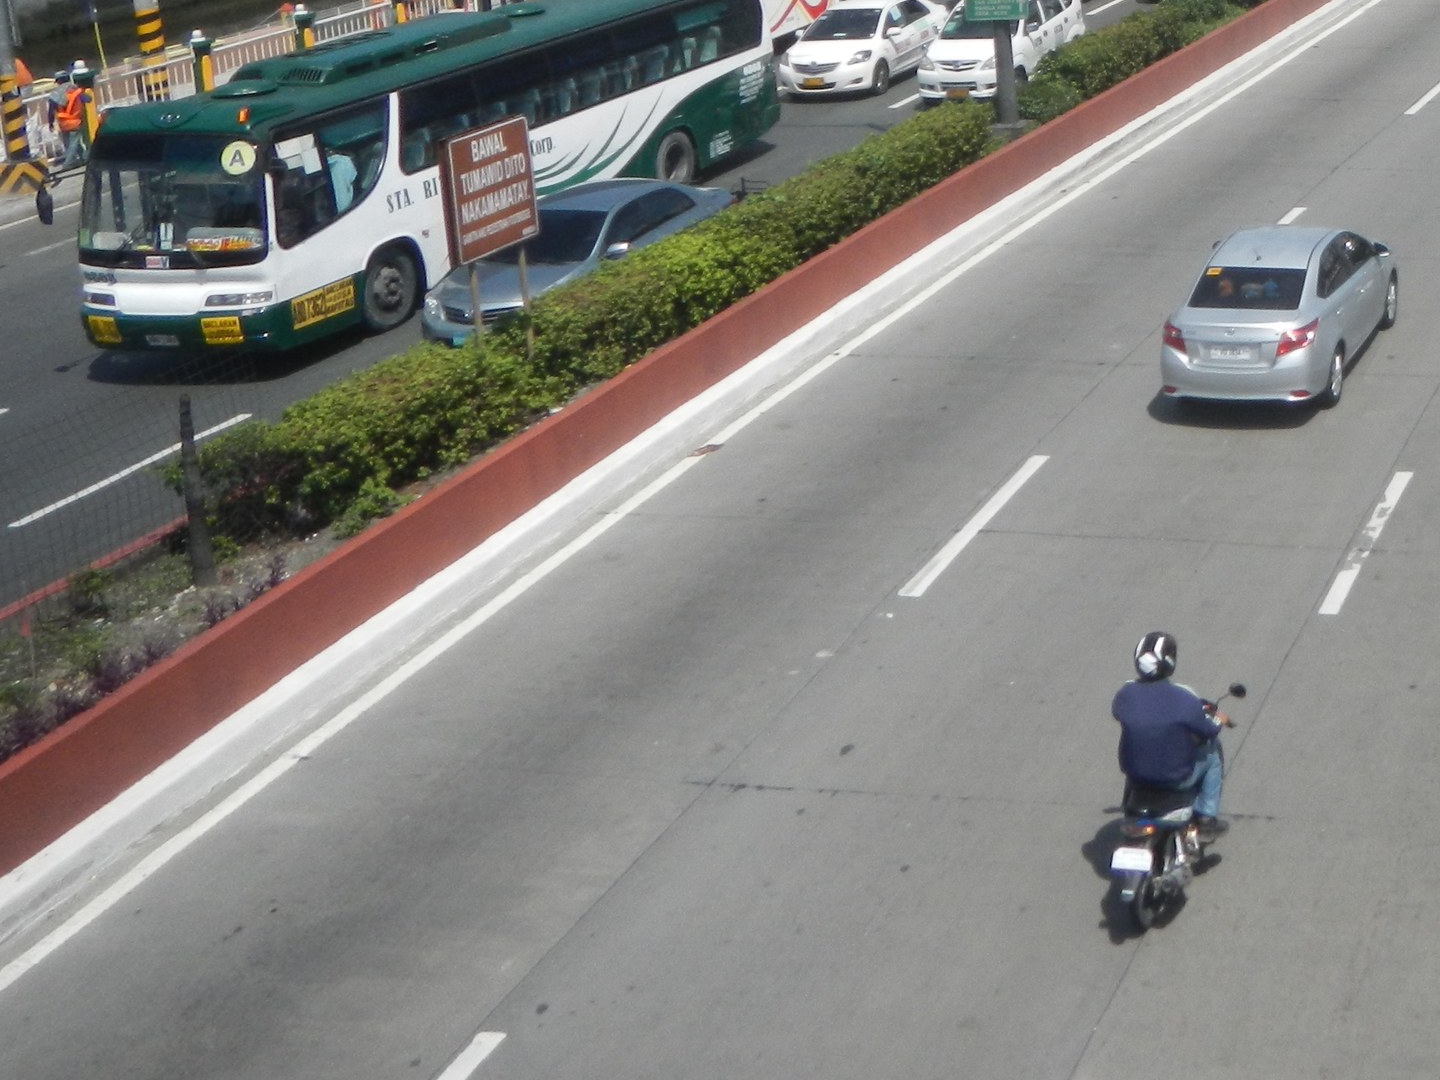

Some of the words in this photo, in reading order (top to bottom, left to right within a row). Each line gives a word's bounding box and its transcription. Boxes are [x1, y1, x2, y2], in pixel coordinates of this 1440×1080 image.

[229, 149, 245, 167] A
[470, 131, 507, 162] BAWAL
[460, 160, 504, 195] TUMAWID
[505, 152, 526, 179] DITO
[386, 188, 415, 214] STA.
[461, 179, 530, 225] NAKAMAMATAY.
